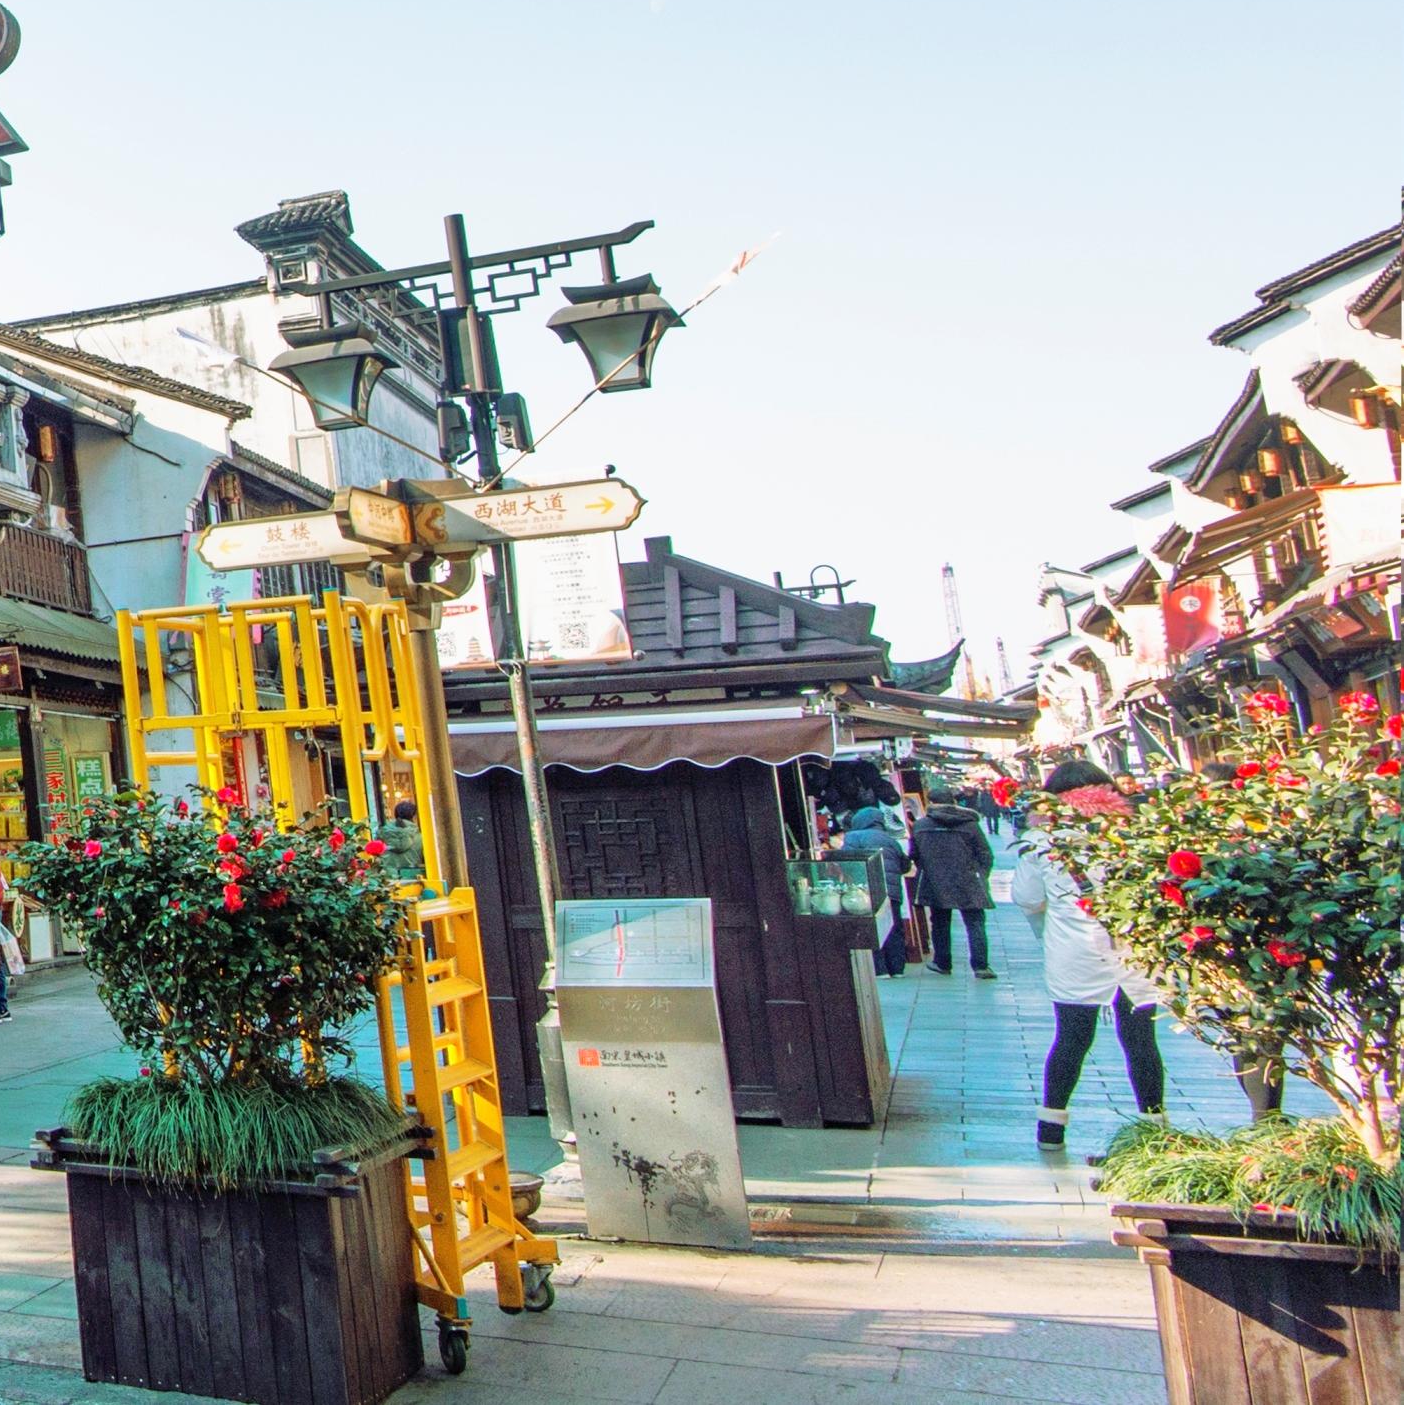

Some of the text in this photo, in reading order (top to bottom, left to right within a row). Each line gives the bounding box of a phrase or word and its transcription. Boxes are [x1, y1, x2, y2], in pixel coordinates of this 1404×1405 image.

[474, 493, 567, 519] 西湖大道
[266, 522, 311, 543] 鼓楼
[600, 994, 673, 1013] 河坊街
